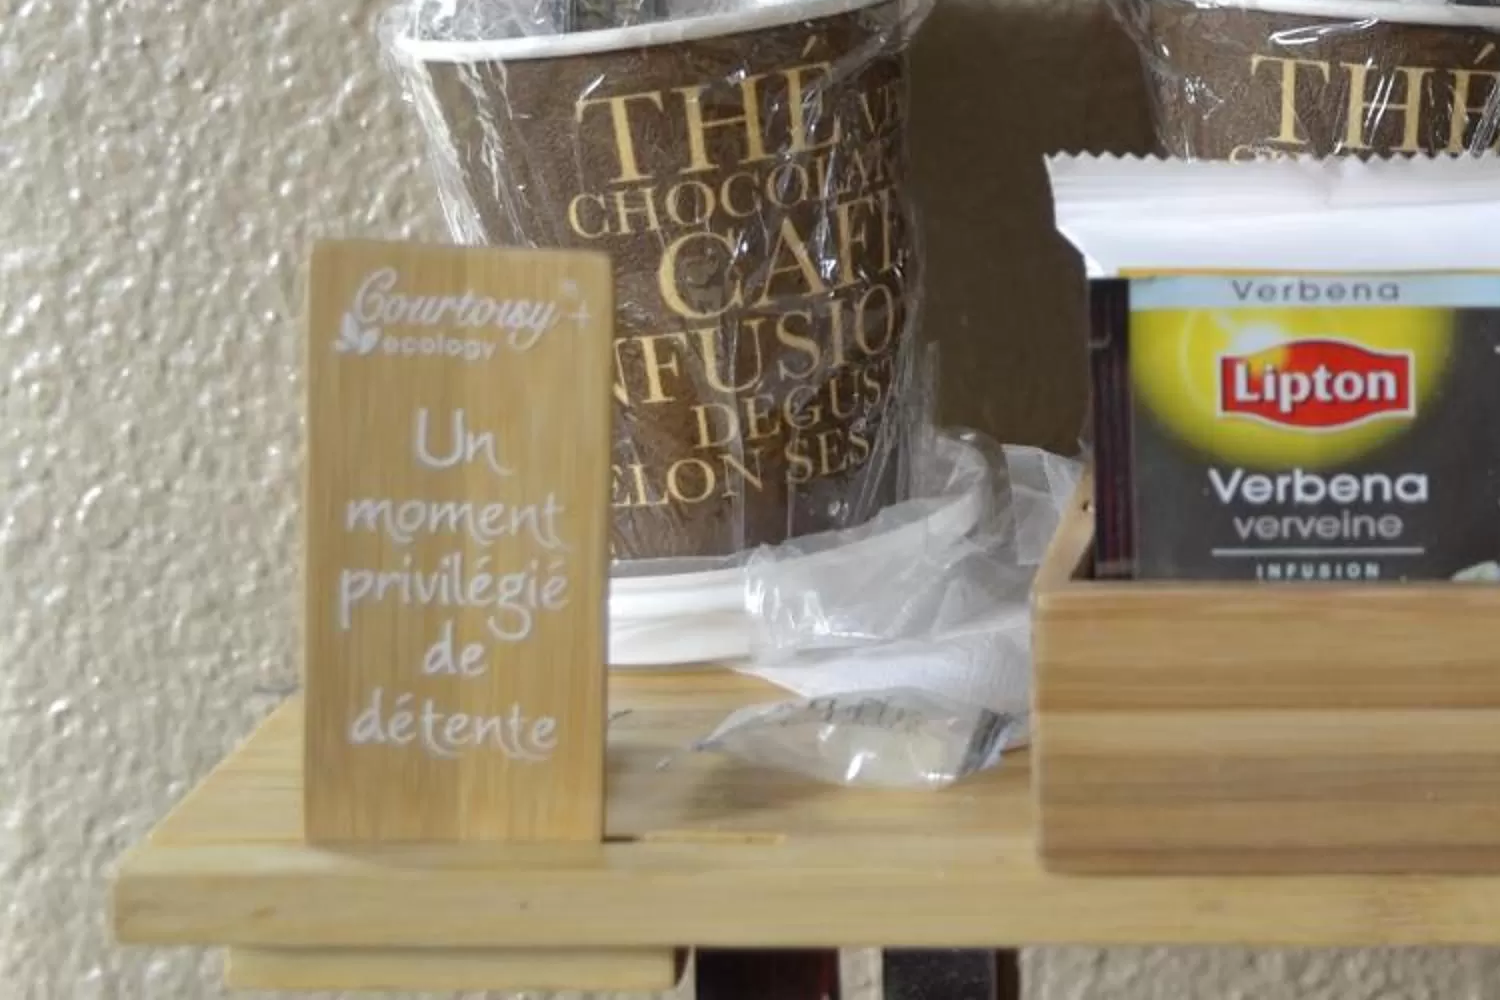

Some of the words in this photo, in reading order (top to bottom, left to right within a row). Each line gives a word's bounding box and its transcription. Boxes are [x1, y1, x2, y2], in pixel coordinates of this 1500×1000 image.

[575, 35, 841, 183] THÉ
[1232, 280, 1401, 302] Verbena
[383, 334, 498, 360] ecology
[1233, 363, 1398, 412] Lipton
[415, 407, 513, 476] Un
[1208, 468, 1429, 504] Verbena
[346, 496, 569, 551] moment
[1233, 511, 1403, 540] verveine
[339, 553, 569, 641] privilégié
[1256, 562, 1379, 580] INFUSION
[423, 621, 487, 677] de
[349, 688, 558, 760] détente
